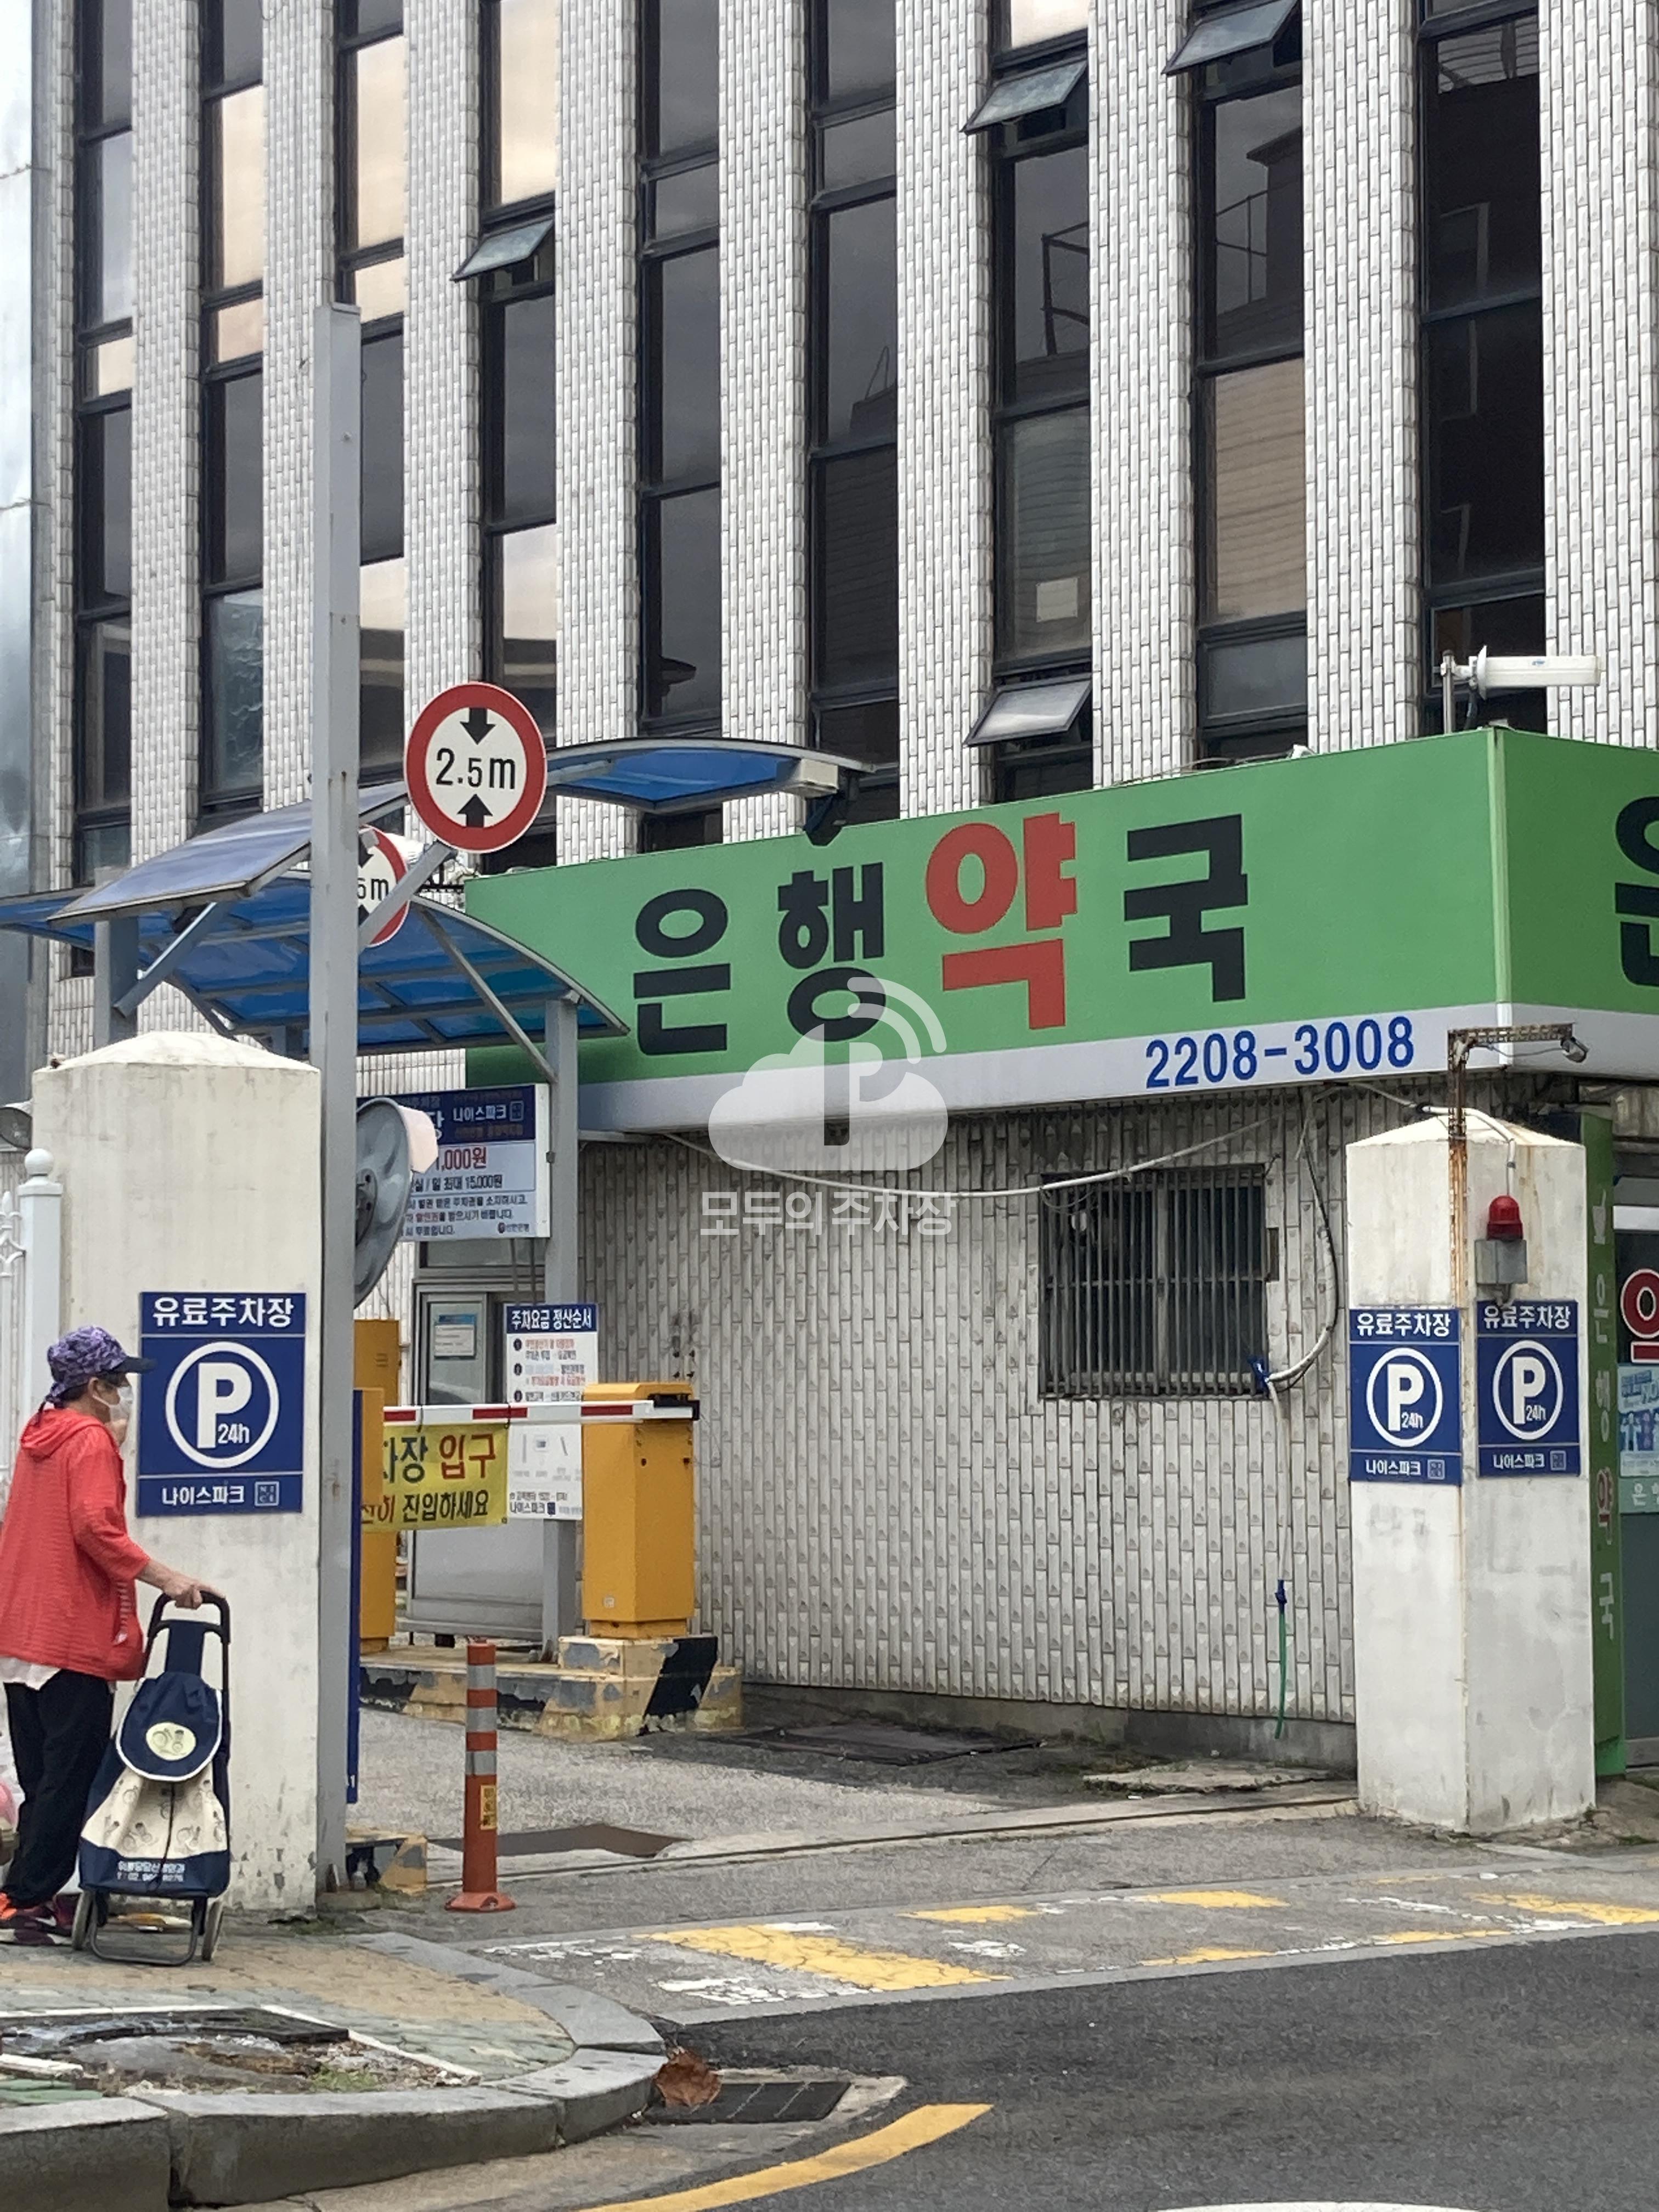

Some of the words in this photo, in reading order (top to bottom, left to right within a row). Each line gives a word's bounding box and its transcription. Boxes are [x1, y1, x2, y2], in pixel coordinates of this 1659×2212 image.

[436, 747, 516, 790] 2.5m
[1146, 1015, 1414, 1089] 2208-3008
[152, 1297, 294, 1328] 유료주차장
[511, 1309, 550, 1330] 주차요금
[553, 1307, 592, 1330] 정산순서
[1483, 1305, 1571, 1330] 유료주차장
[1356, 1312, 1451, 1338] 유료주차장
[1401, 1412, 1424, 1429] 24h
[1525, 1403, 1547, 1421] 24h
[217, 1423, 250, 1444] 24h
[439, 1433, 496, 1480] 입구
[1365, 1459, 1421, 1476] 나이스파크
[1492, 1453, 1545, 1470] 나이스파크
[162, 1485, 245, 1506] 나이스파크
[402, 1489, 489, 1523] 진입하세요
